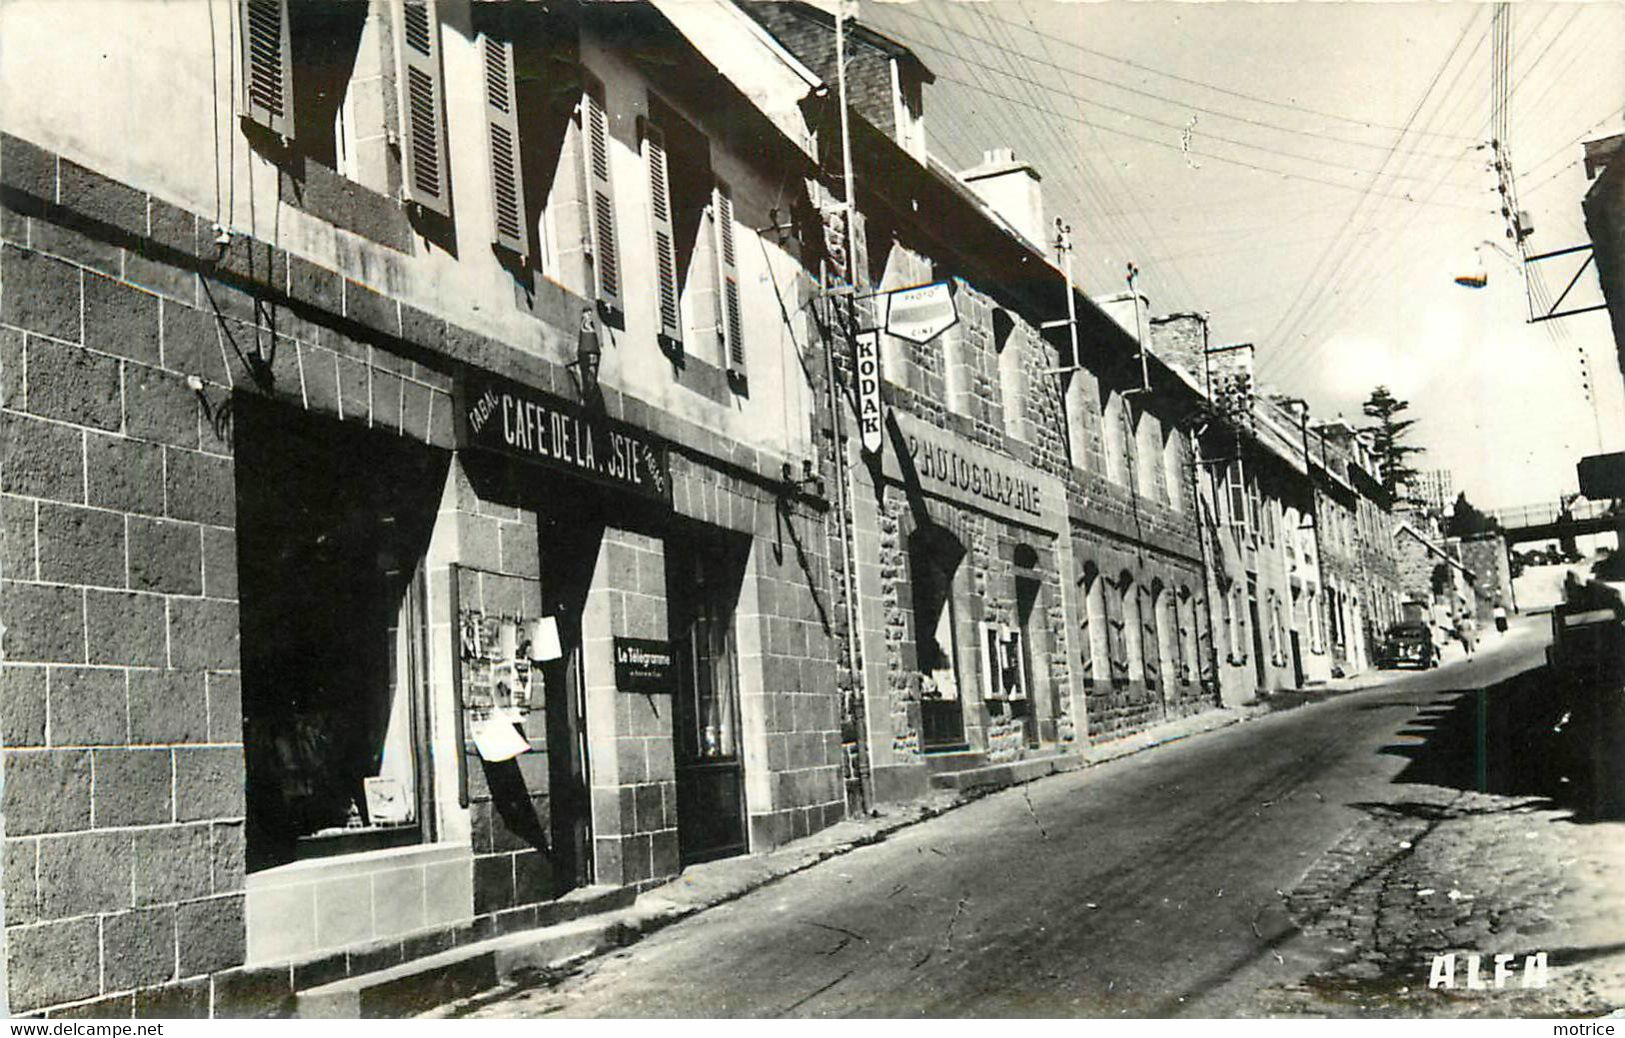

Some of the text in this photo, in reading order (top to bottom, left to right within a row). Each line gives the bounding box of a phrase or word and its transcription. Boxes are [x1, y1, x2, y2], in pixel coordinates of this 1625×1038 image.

[469, 389, 500, 433] TABAC
[859, 342, 880, 434] KODAK
[502, 393, 549, 455] CAFE
[552, 411, 572, 463] DE
[575, 418, 596, 470] LA
[909, 436, 1042, 516] PHOTOGRAPHIE
[617, 647, 628, 663] Le
